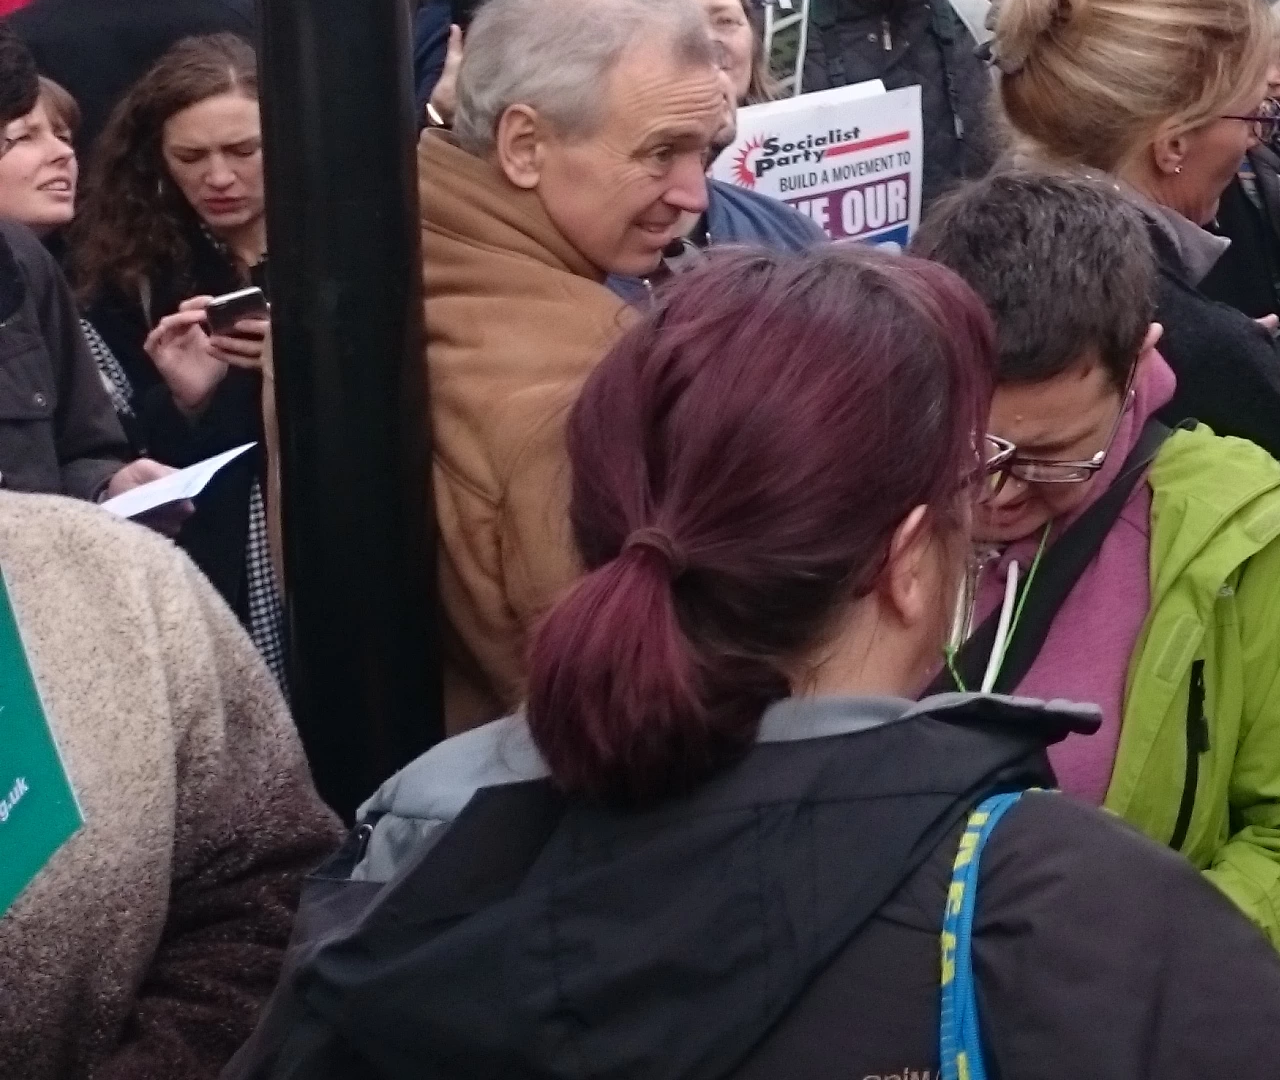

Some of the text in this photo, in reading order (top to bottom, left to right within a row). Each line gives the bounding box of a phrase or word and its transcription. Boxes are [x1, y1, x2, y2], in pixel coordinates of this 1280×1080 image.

[762, 126, 861, 157] Socialist
[779, 150, 911, 193] BUILD A MOVEMENT TO
[841, 178, 908, 236] OUR
